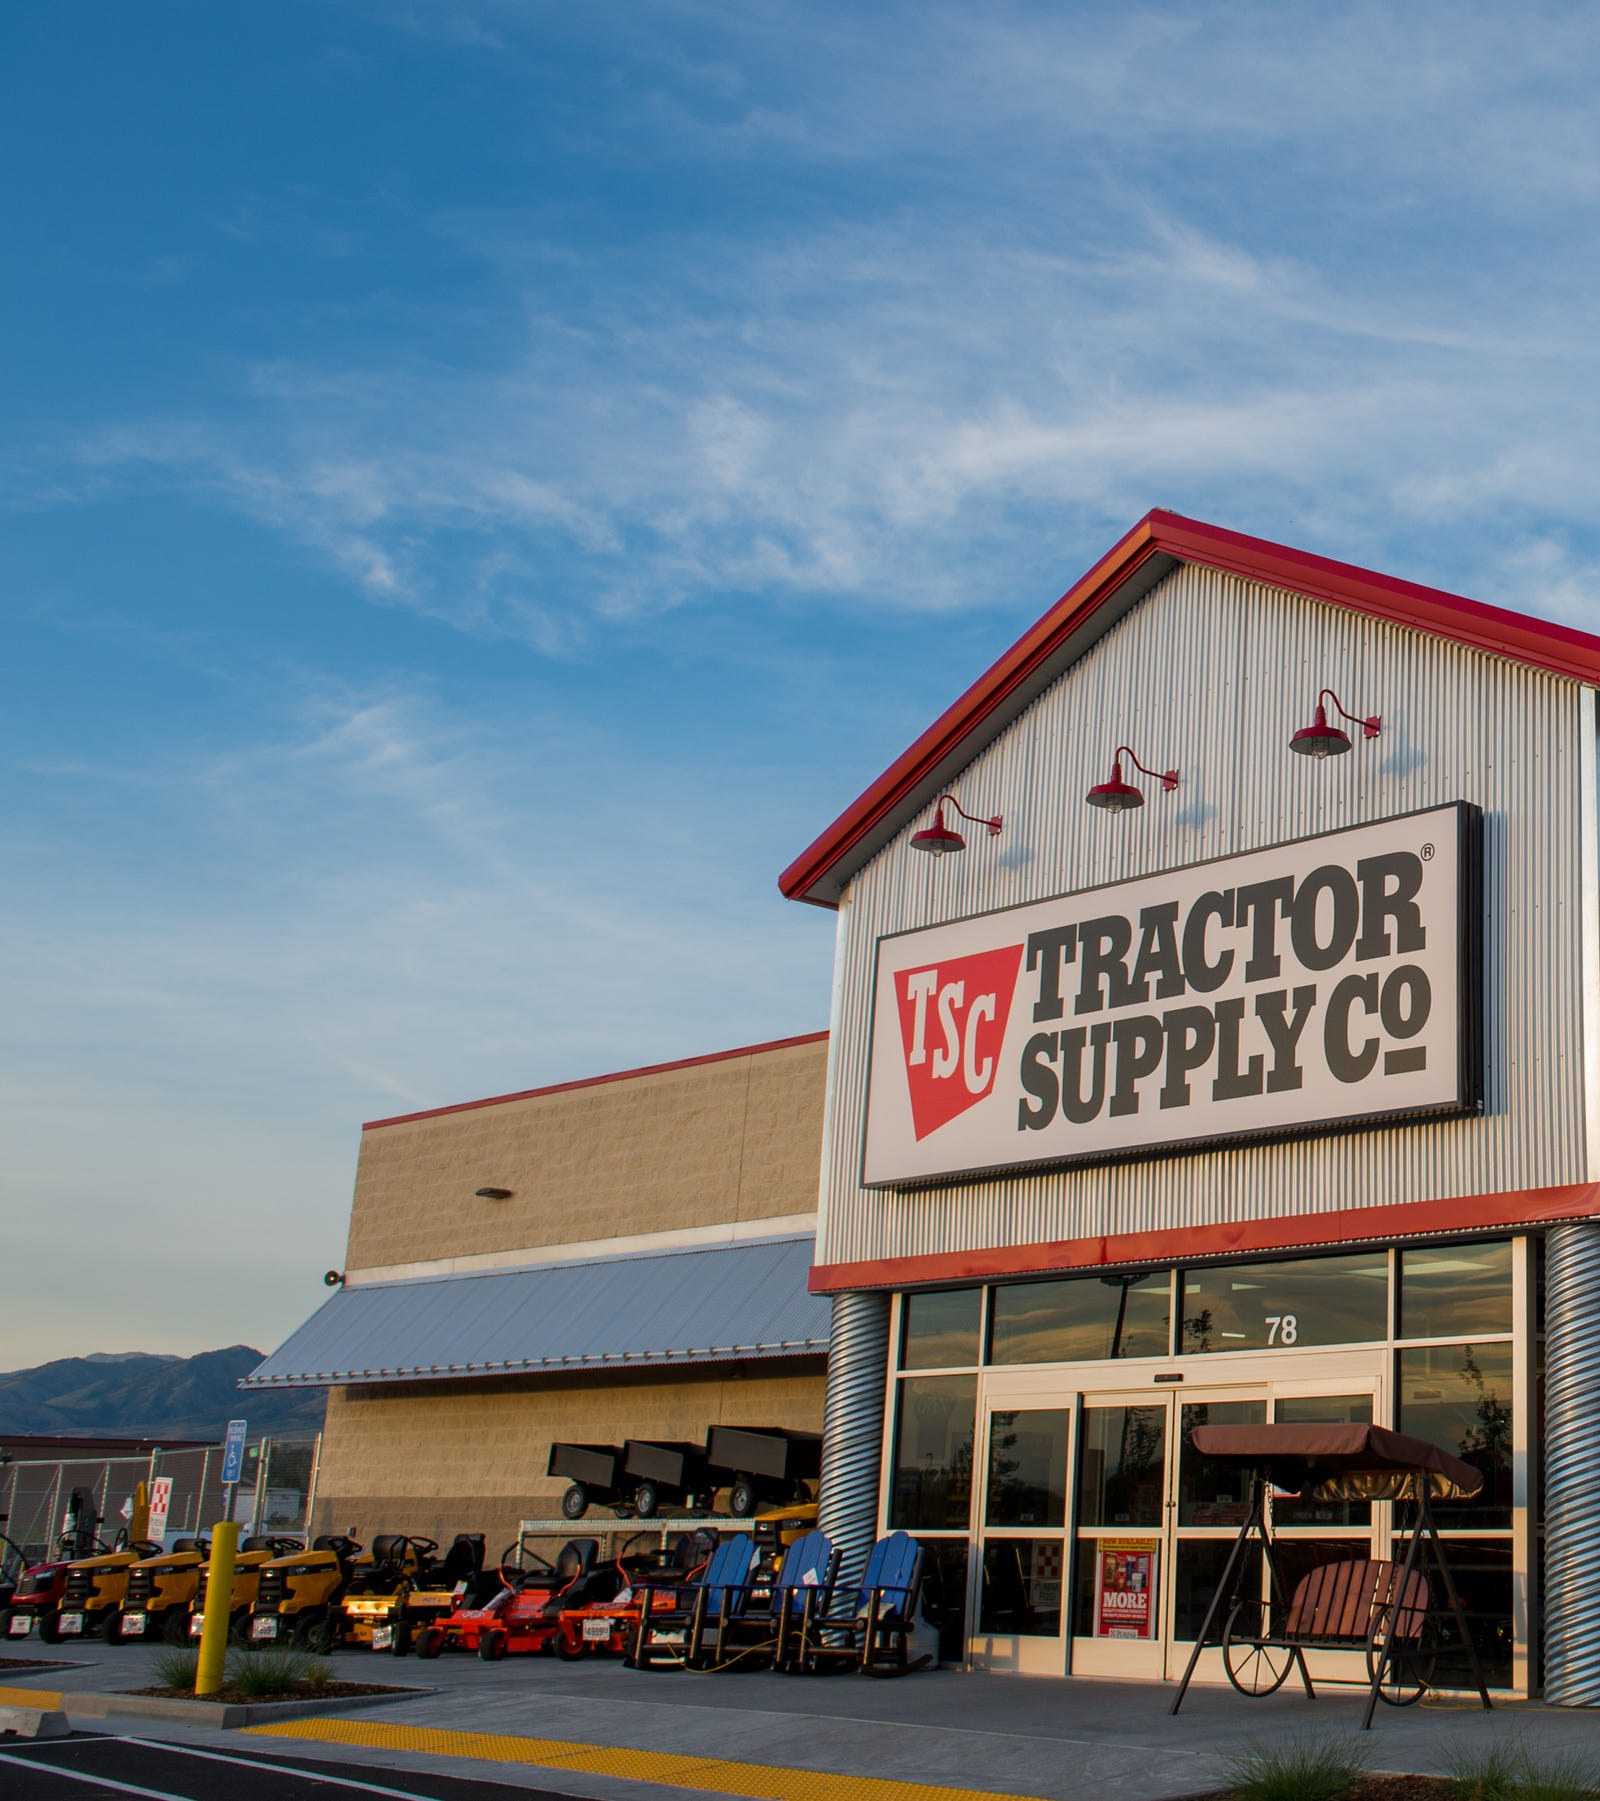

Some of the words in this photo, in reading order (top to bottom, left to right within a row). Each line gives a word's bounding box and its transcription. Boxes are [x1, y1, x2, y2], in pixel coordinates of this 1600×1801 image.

[1026, 850, 1426, 1023] TRACTOR
[907, 969, 996, 1095] TSC
[1018, 984, 1317, 1132] SUPPLY
[1265, 1315, 1297, 1345] 78
[1103, 1592, 1147, 1608] MORE
